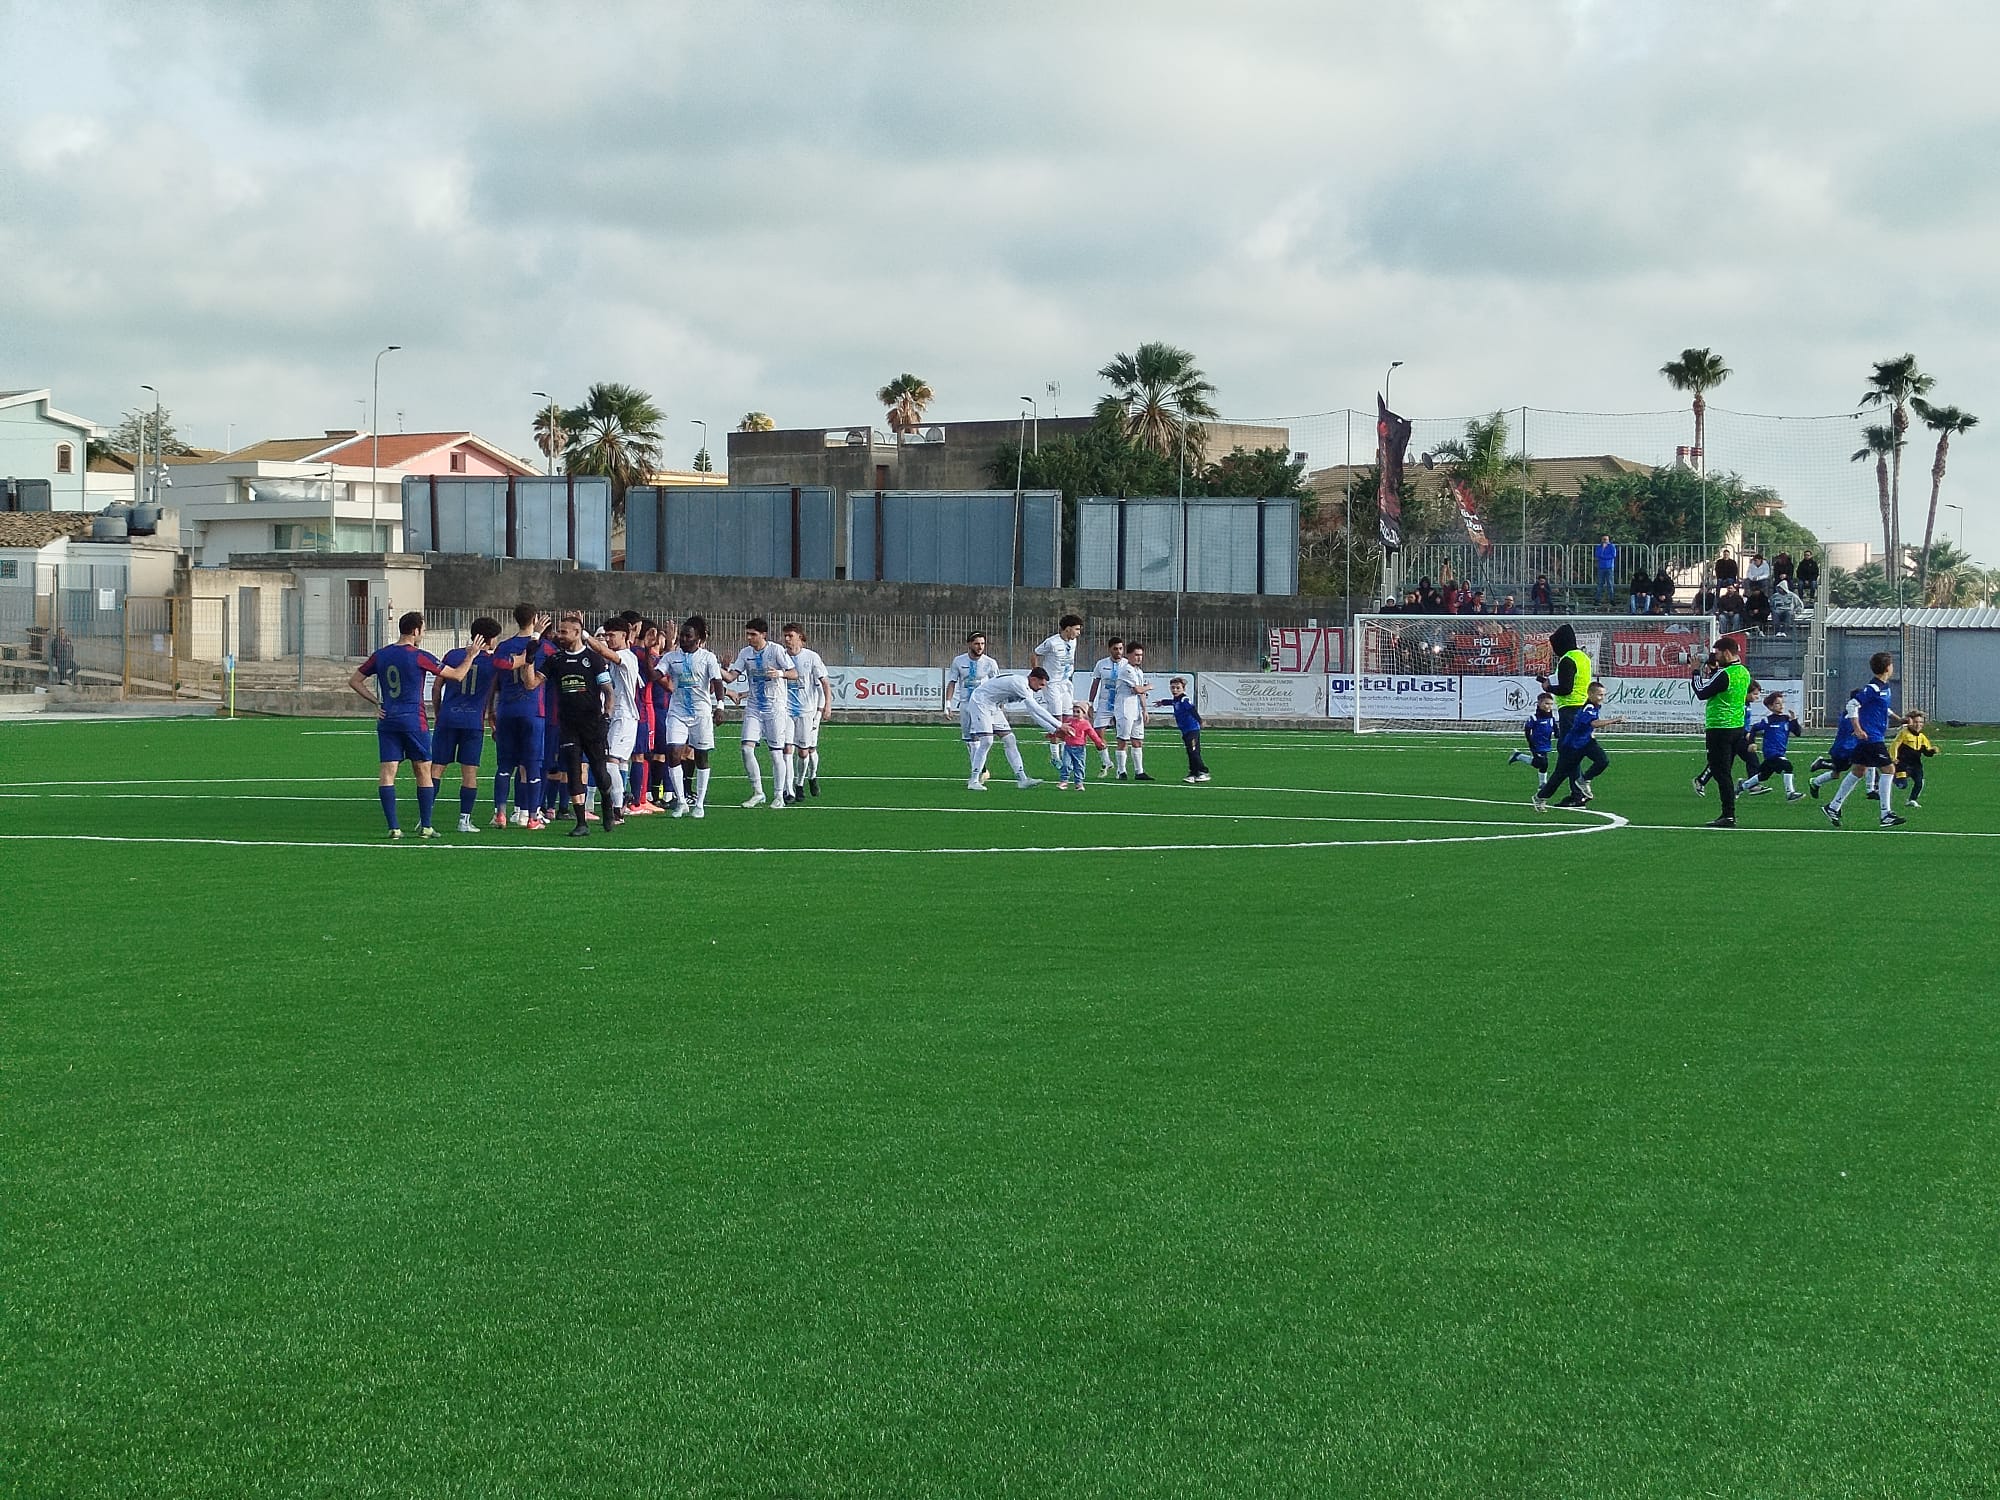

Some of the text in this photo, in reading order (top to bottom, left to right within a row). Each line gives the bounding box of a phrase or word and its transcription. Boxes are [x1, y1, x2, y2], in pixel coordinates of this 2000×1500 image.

[1474, 638, 1499, 646] FIGLI
[1480, 648, 1491, 656] DI
[1468, 656, 1500, 665] SCICLI
[387, 665, 401, 698] 9
[461, 664, 478, 695] 11
[1605, 680, 1645, 704] Arte
[1649, 680, 1676, 699] del
